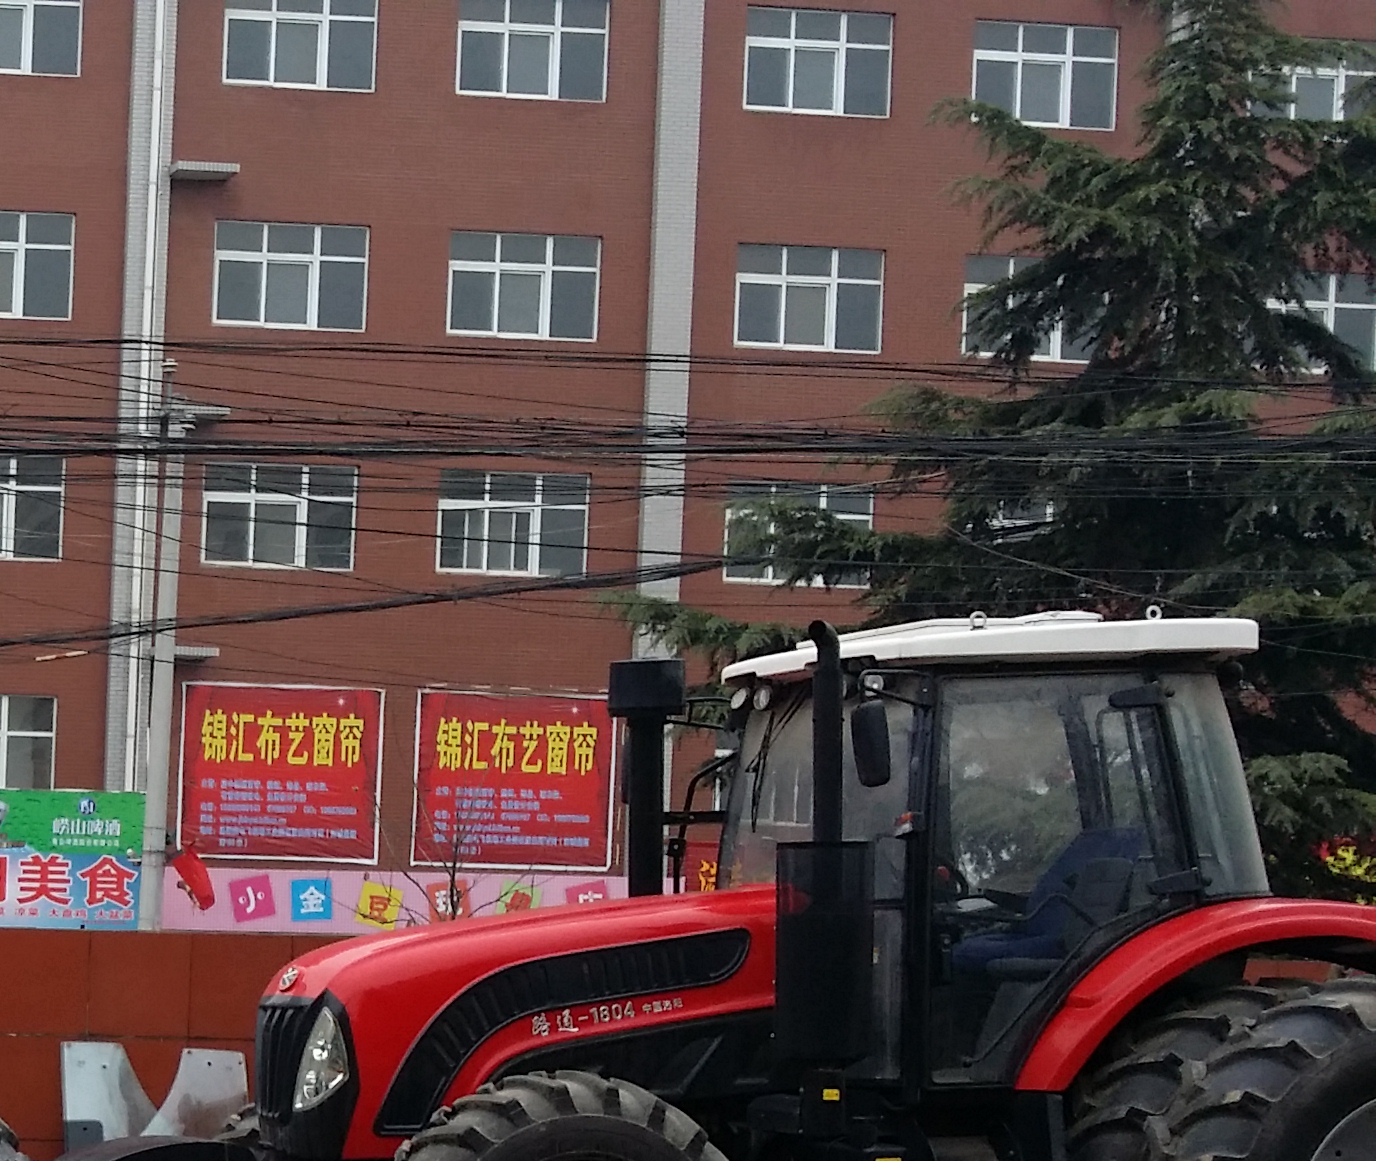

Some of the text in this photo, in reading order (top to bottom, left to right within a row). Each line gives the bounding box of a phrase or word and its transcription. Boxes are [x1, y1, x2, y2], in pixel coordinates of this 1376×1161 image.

[201, 709, 364, 767] 锦汇布艺窗帘
[436, 717, 598, 775] 锦汇布艺窗帘
[53, 818, 120, 836] 崂山啤酒
